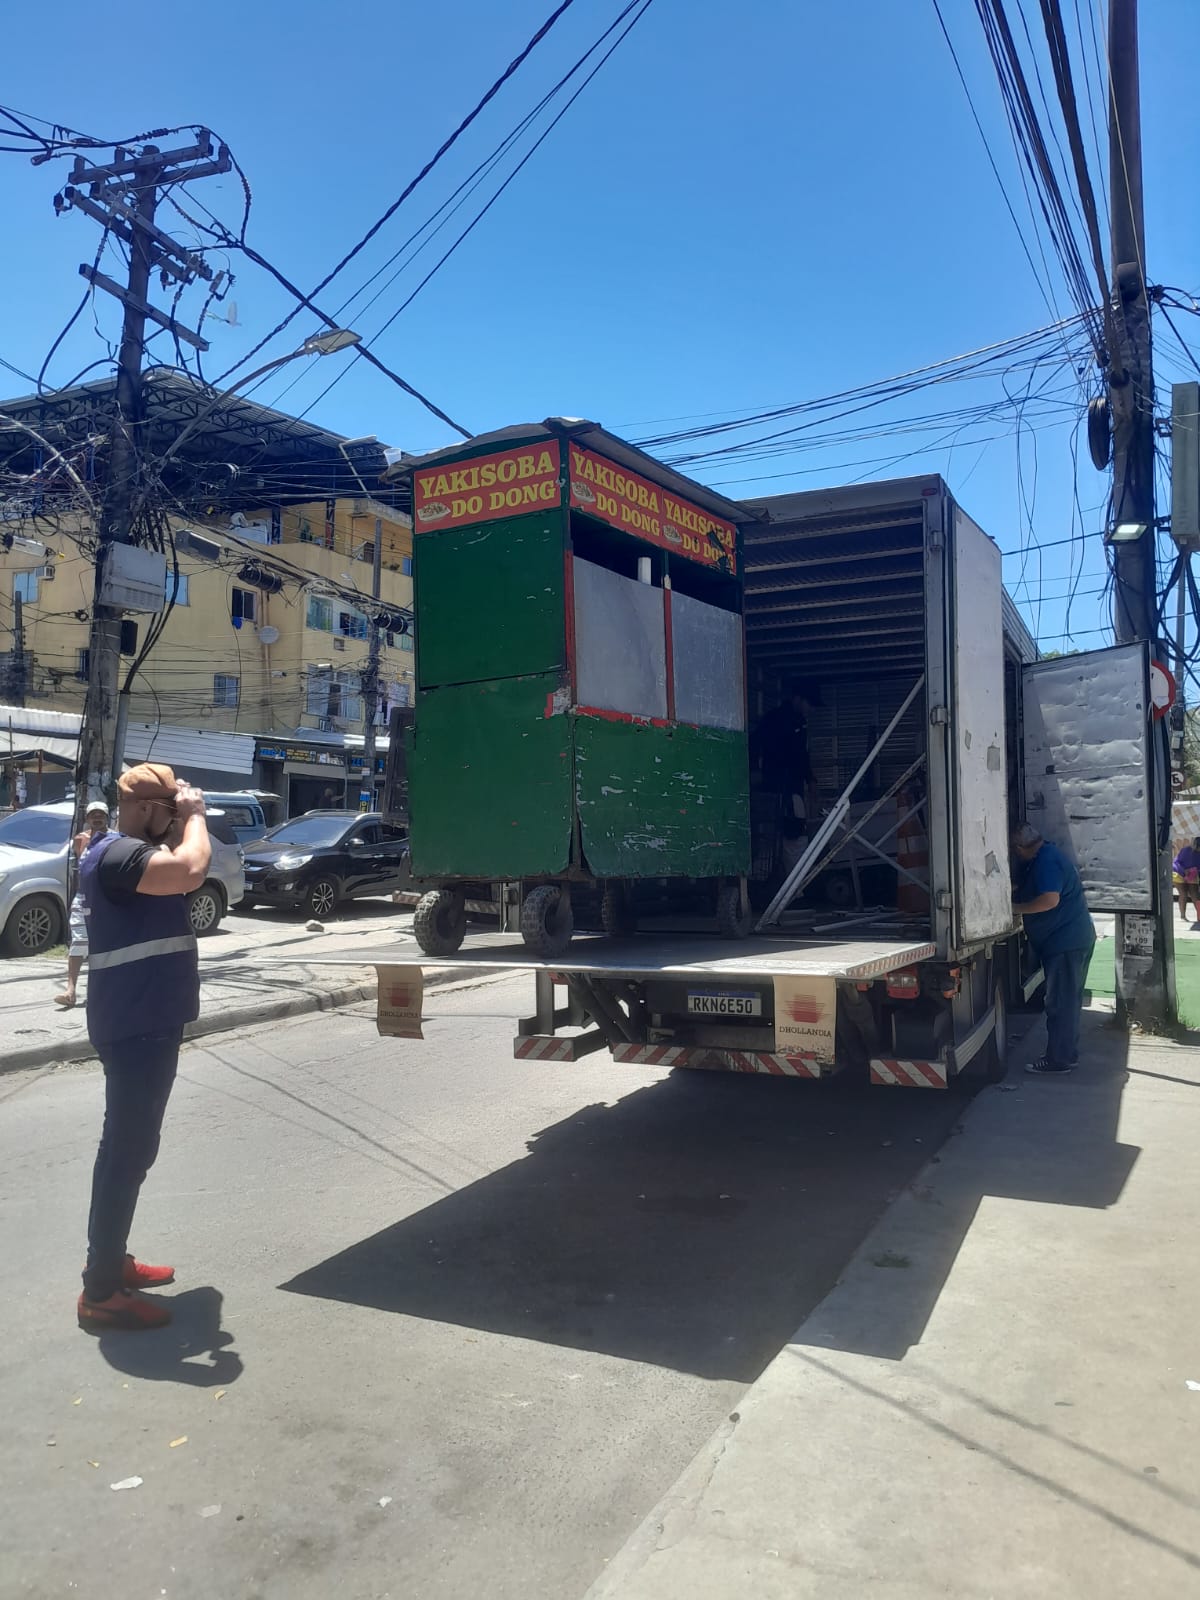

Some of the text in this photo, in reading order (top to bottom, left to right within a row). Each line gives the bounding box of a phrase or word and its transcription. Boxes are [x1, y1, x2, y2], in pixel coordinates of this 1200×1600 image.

[419, 451, 556, 499] YAKISOBA
[572, 452, 659, 514] YAKISOBA
[451, 480, 556, 518] DO DONG
[596, 492, 660, 537] DO DONG
[682, 533, 700, 554] DO
[693, 997, 753, 1014] RKN6E50
[779, 1026, 832, 1038] DHOLLANDIA
